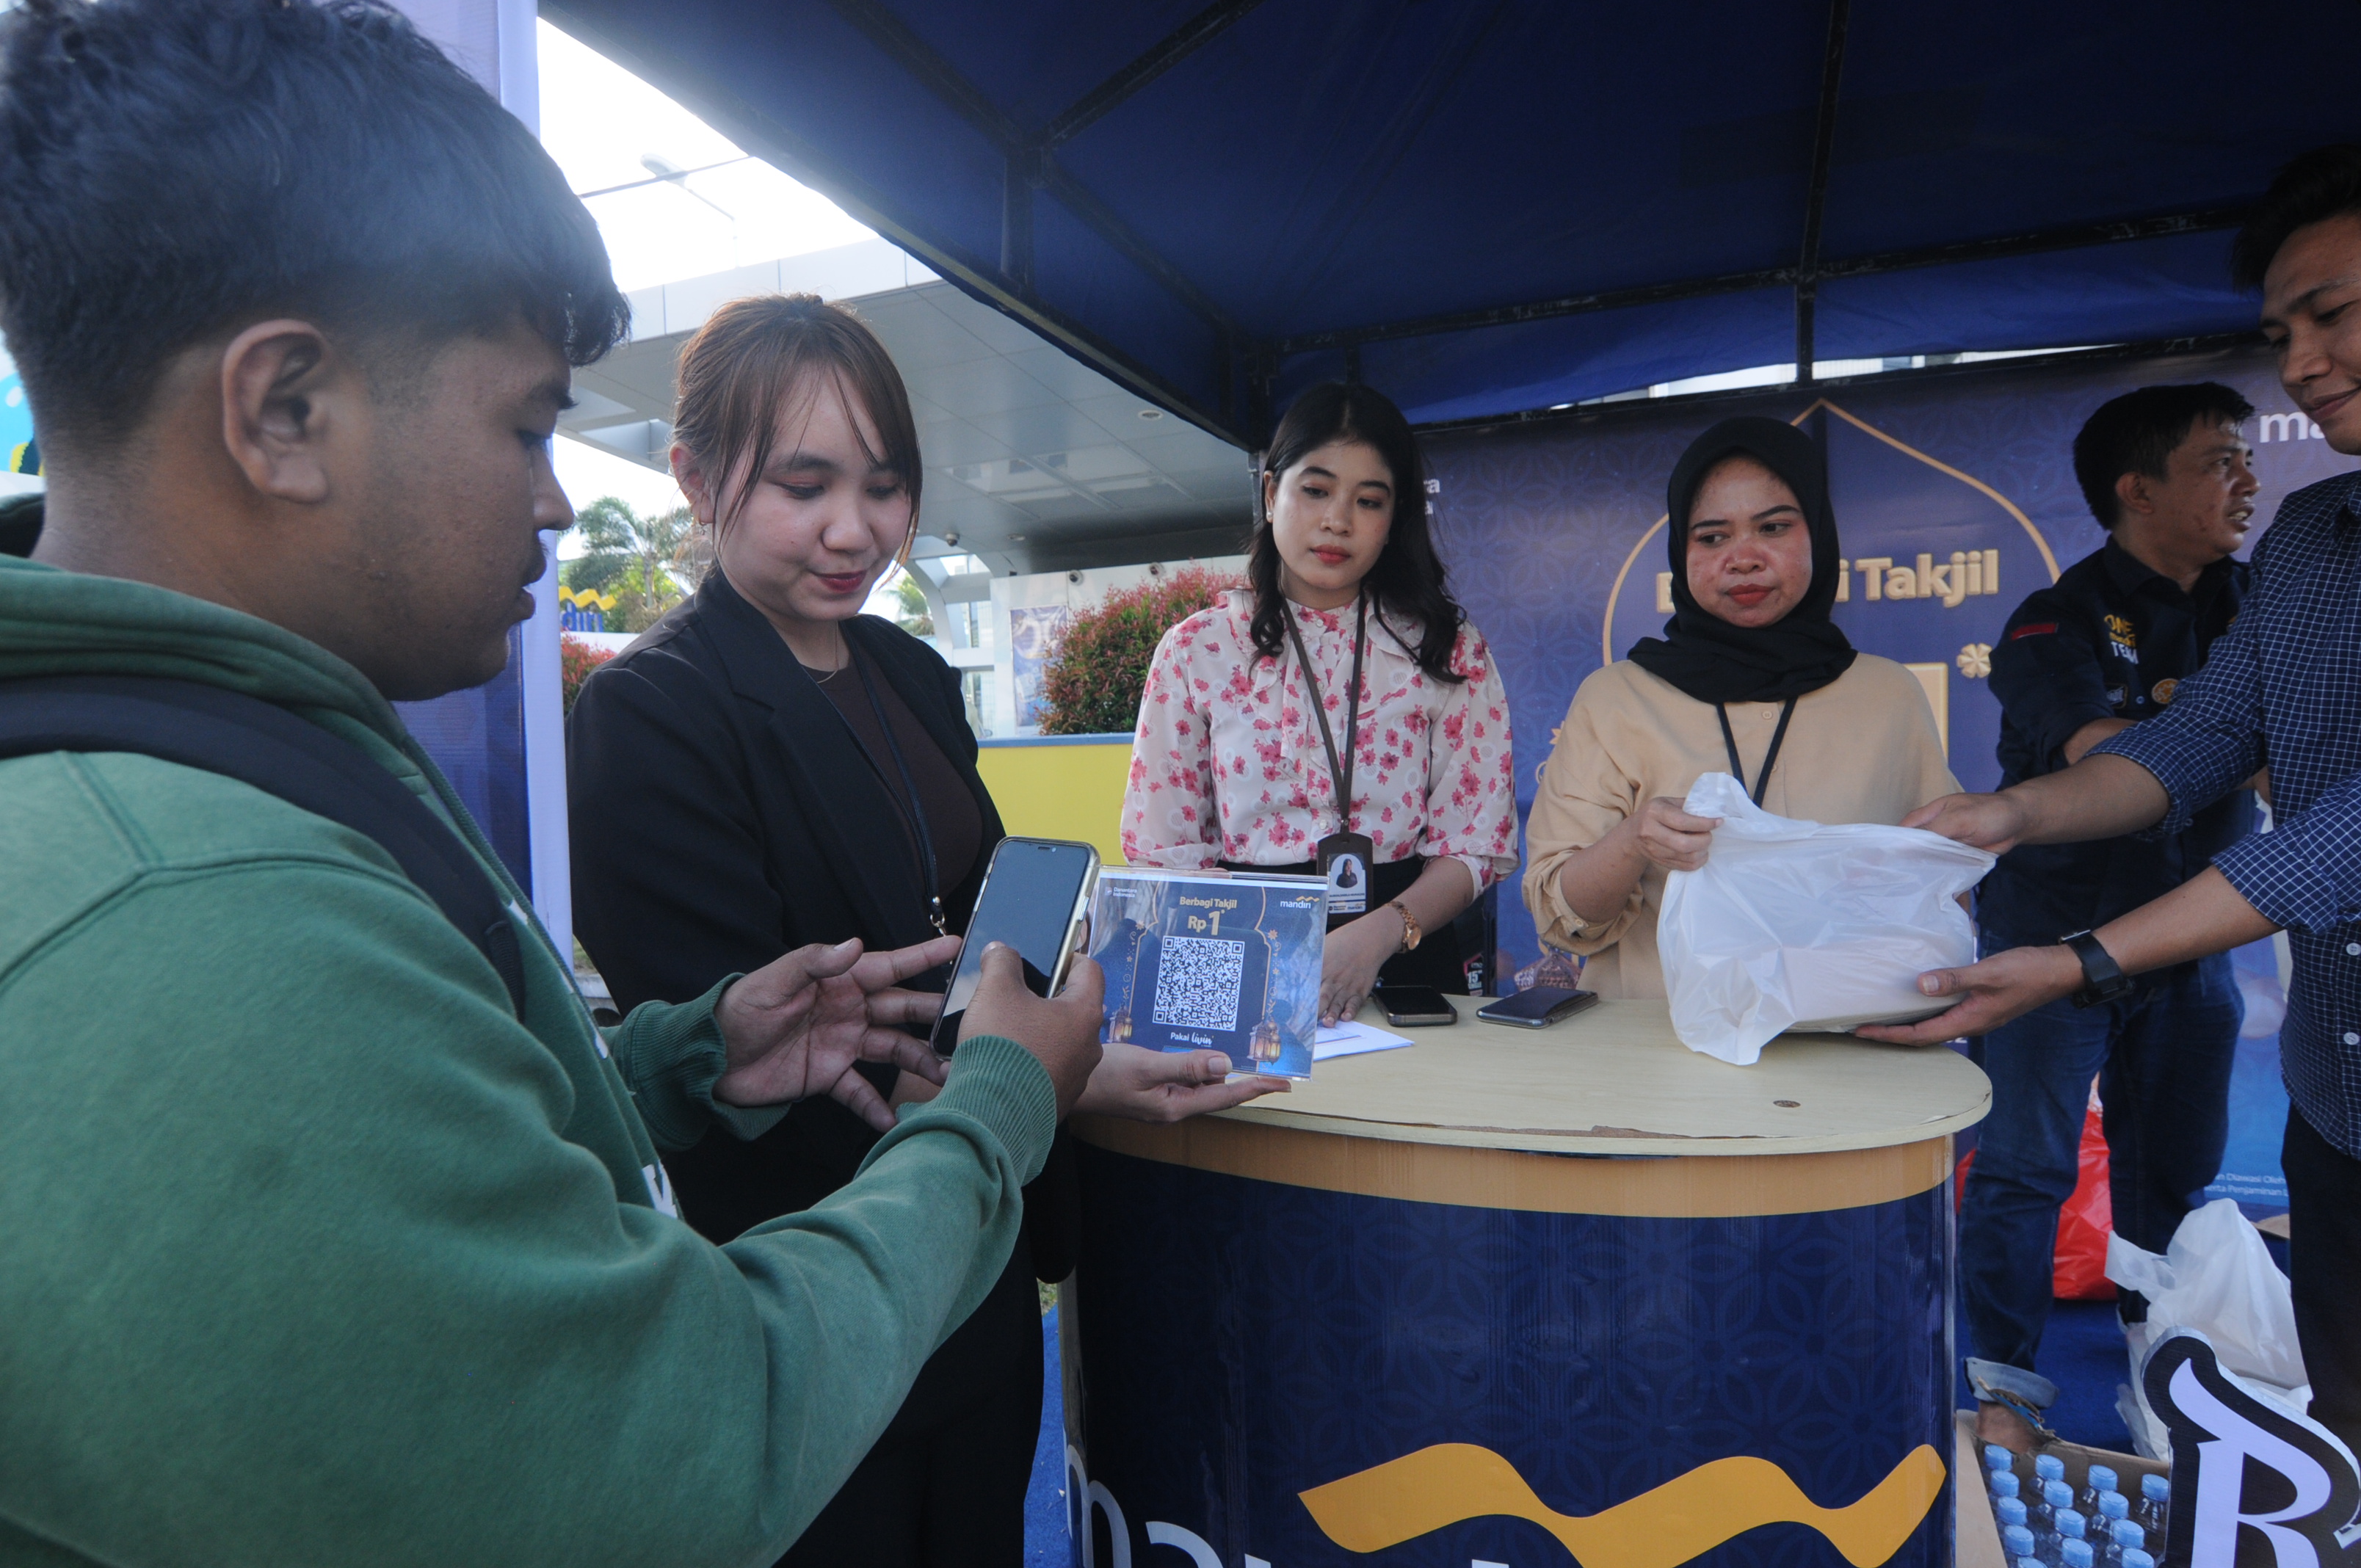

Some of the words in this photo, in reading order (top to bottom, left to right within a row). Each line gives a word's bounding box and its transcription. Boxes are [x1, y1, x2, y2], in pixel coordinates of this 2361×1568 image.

[1855, 549, 1999, 608] Takjil
[1179, 896, 1214, 909] Berbagi
[1214, 898, 1238, 910] Takjil
[1280, 900, 1312, 910] mandiri
[1170, 1031, 1189, 1042] Pakai
